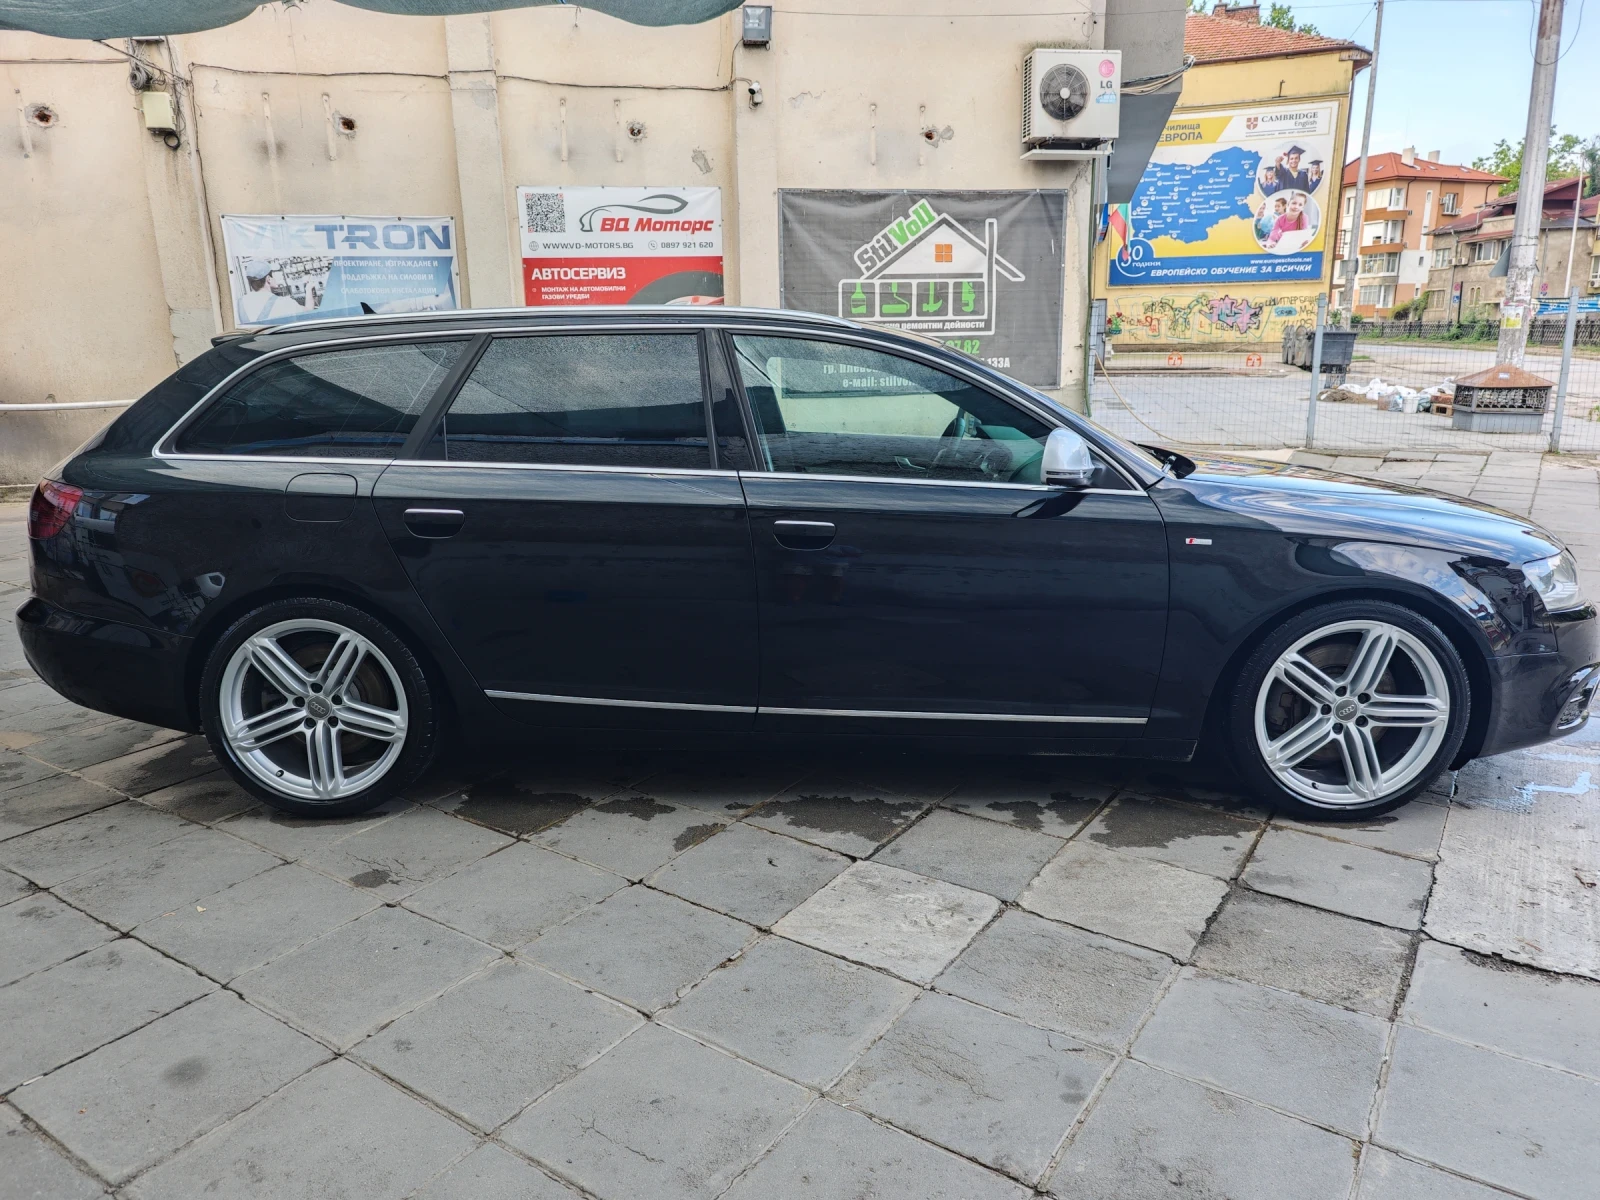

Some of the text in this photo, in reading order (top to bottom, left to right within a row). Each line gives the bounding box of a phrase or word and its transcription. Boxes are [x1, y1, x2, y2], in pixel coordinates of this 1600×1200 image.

[1100, 80, 1113, 89] LG
[1261, 111, 1318, 122] CAMBRIDGE
[1294, 120, 1317, 128] English
[1159, 131, 1203, 142] ЕВРОПА
[634, 217, 714, 235] Моторс
[857, 202, 936, 273] StilVoll
[542, 242, 634, 250] WWW.VD-MOTORS.BG
[661, 241, 714, 249] 0897 921 620
[334, 260, 384, 268] ПРОЕКТИРАНЕ,
[385, 260, 431, 268] ИЗГРАЖДАНЕ
[531, 267, 626, 280] АВТОСЕРВИЗ
[1150, 264, 1312, 277] ЕВРОПЕЙСКО ОБУЧЕНИЕ ЗА ВСИЧКИ
[342, 273, 387, 281] ПОДДРЪЖКА
[901, 322, 943, 330] ремонтни
[944, 320, 985, 330] дейности
[964, 339, 980, 354] 82
